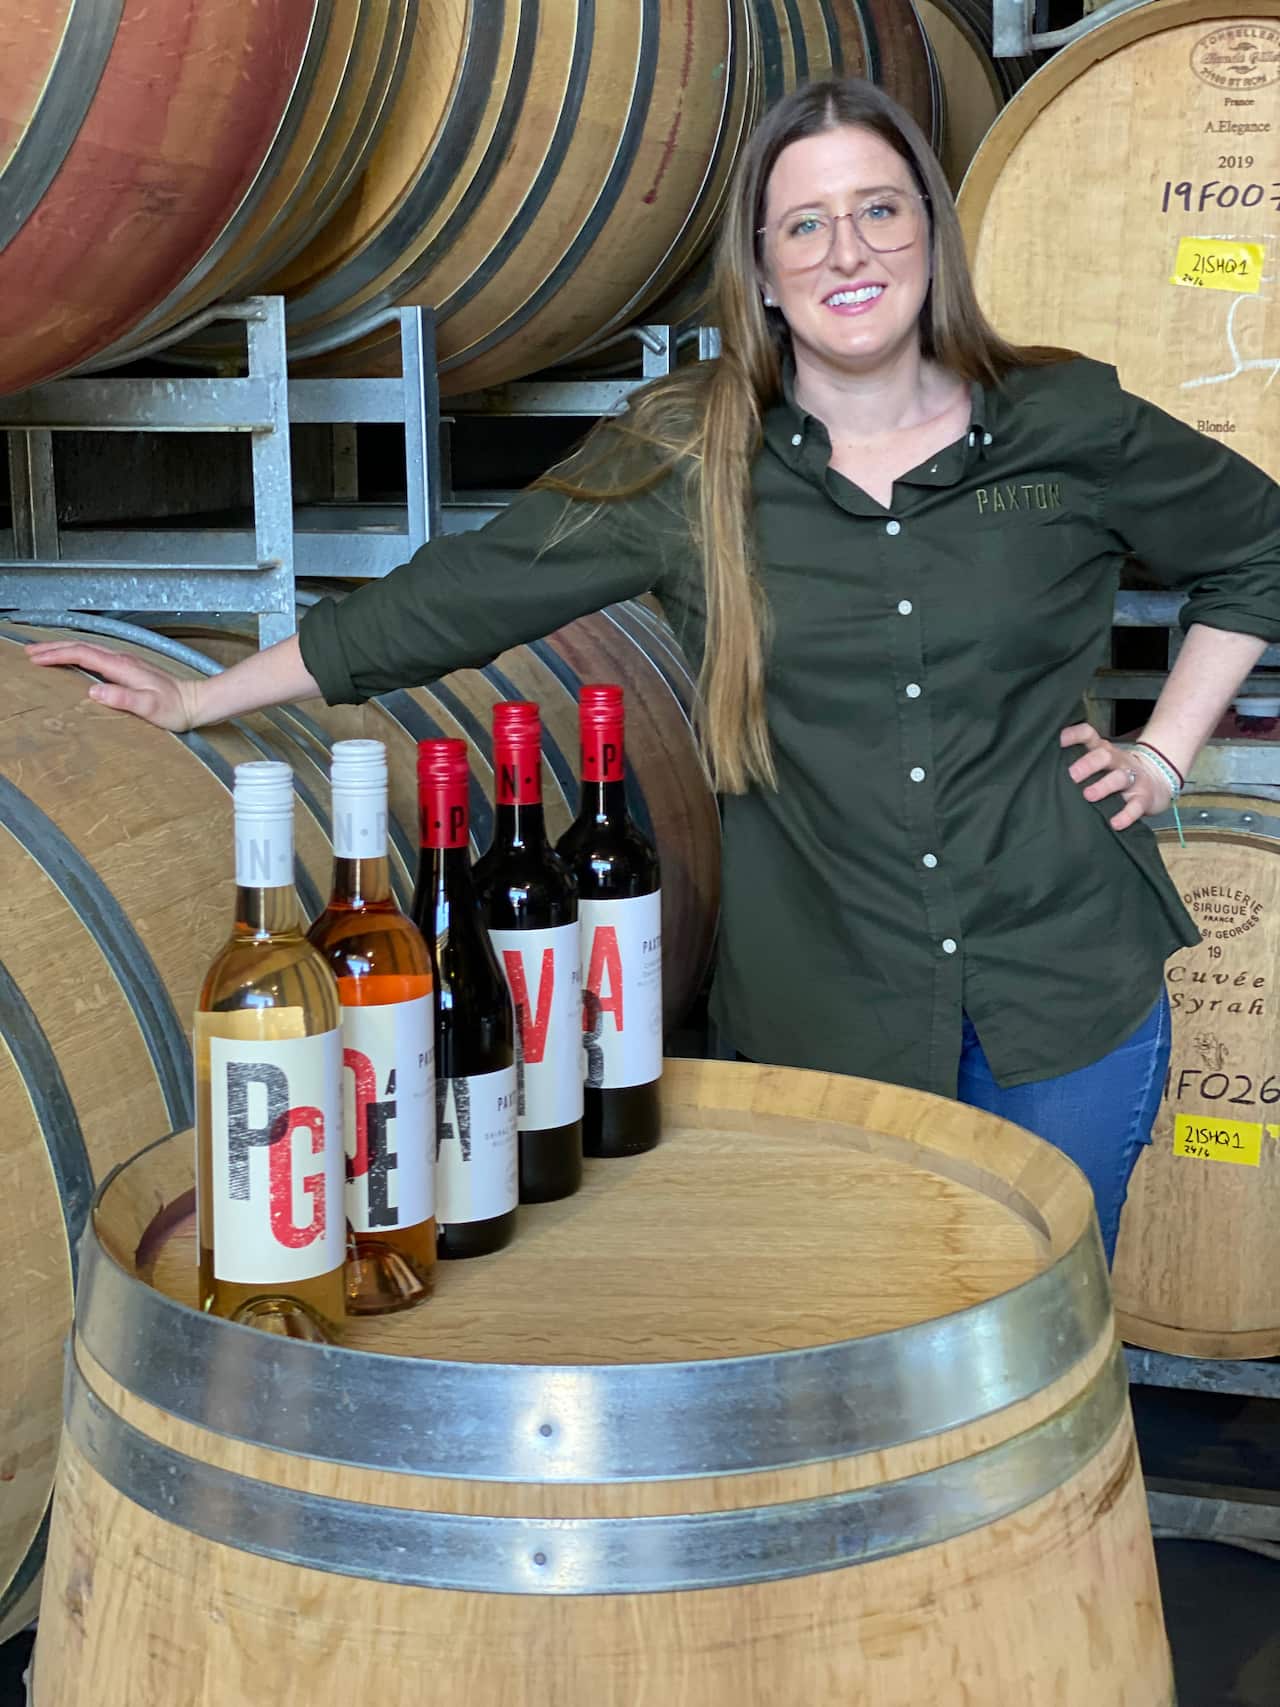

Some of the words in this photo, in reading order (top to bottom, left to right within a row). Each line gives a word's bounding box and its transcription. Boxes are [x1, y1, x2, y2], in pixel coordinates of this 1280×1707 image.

[1218, 155, 1254, 168] 2019
[1198, 420, 1236, 432] Blonde
[976, 482, 1061, 514] PAXTON
[1184, 886, 1264, 923] ONNELLERIE
[1192, 902, 1247, 916] SIRUGUE
[1203, 915, 1235, 923] FRANCE
[1215, 914, 1260, 939] GEORGES
[1207, 945, 1222, 959] 19
[1166, 966, 1265, 989] Cuvée
[1170, 986, 1265, 1016] Syrah
